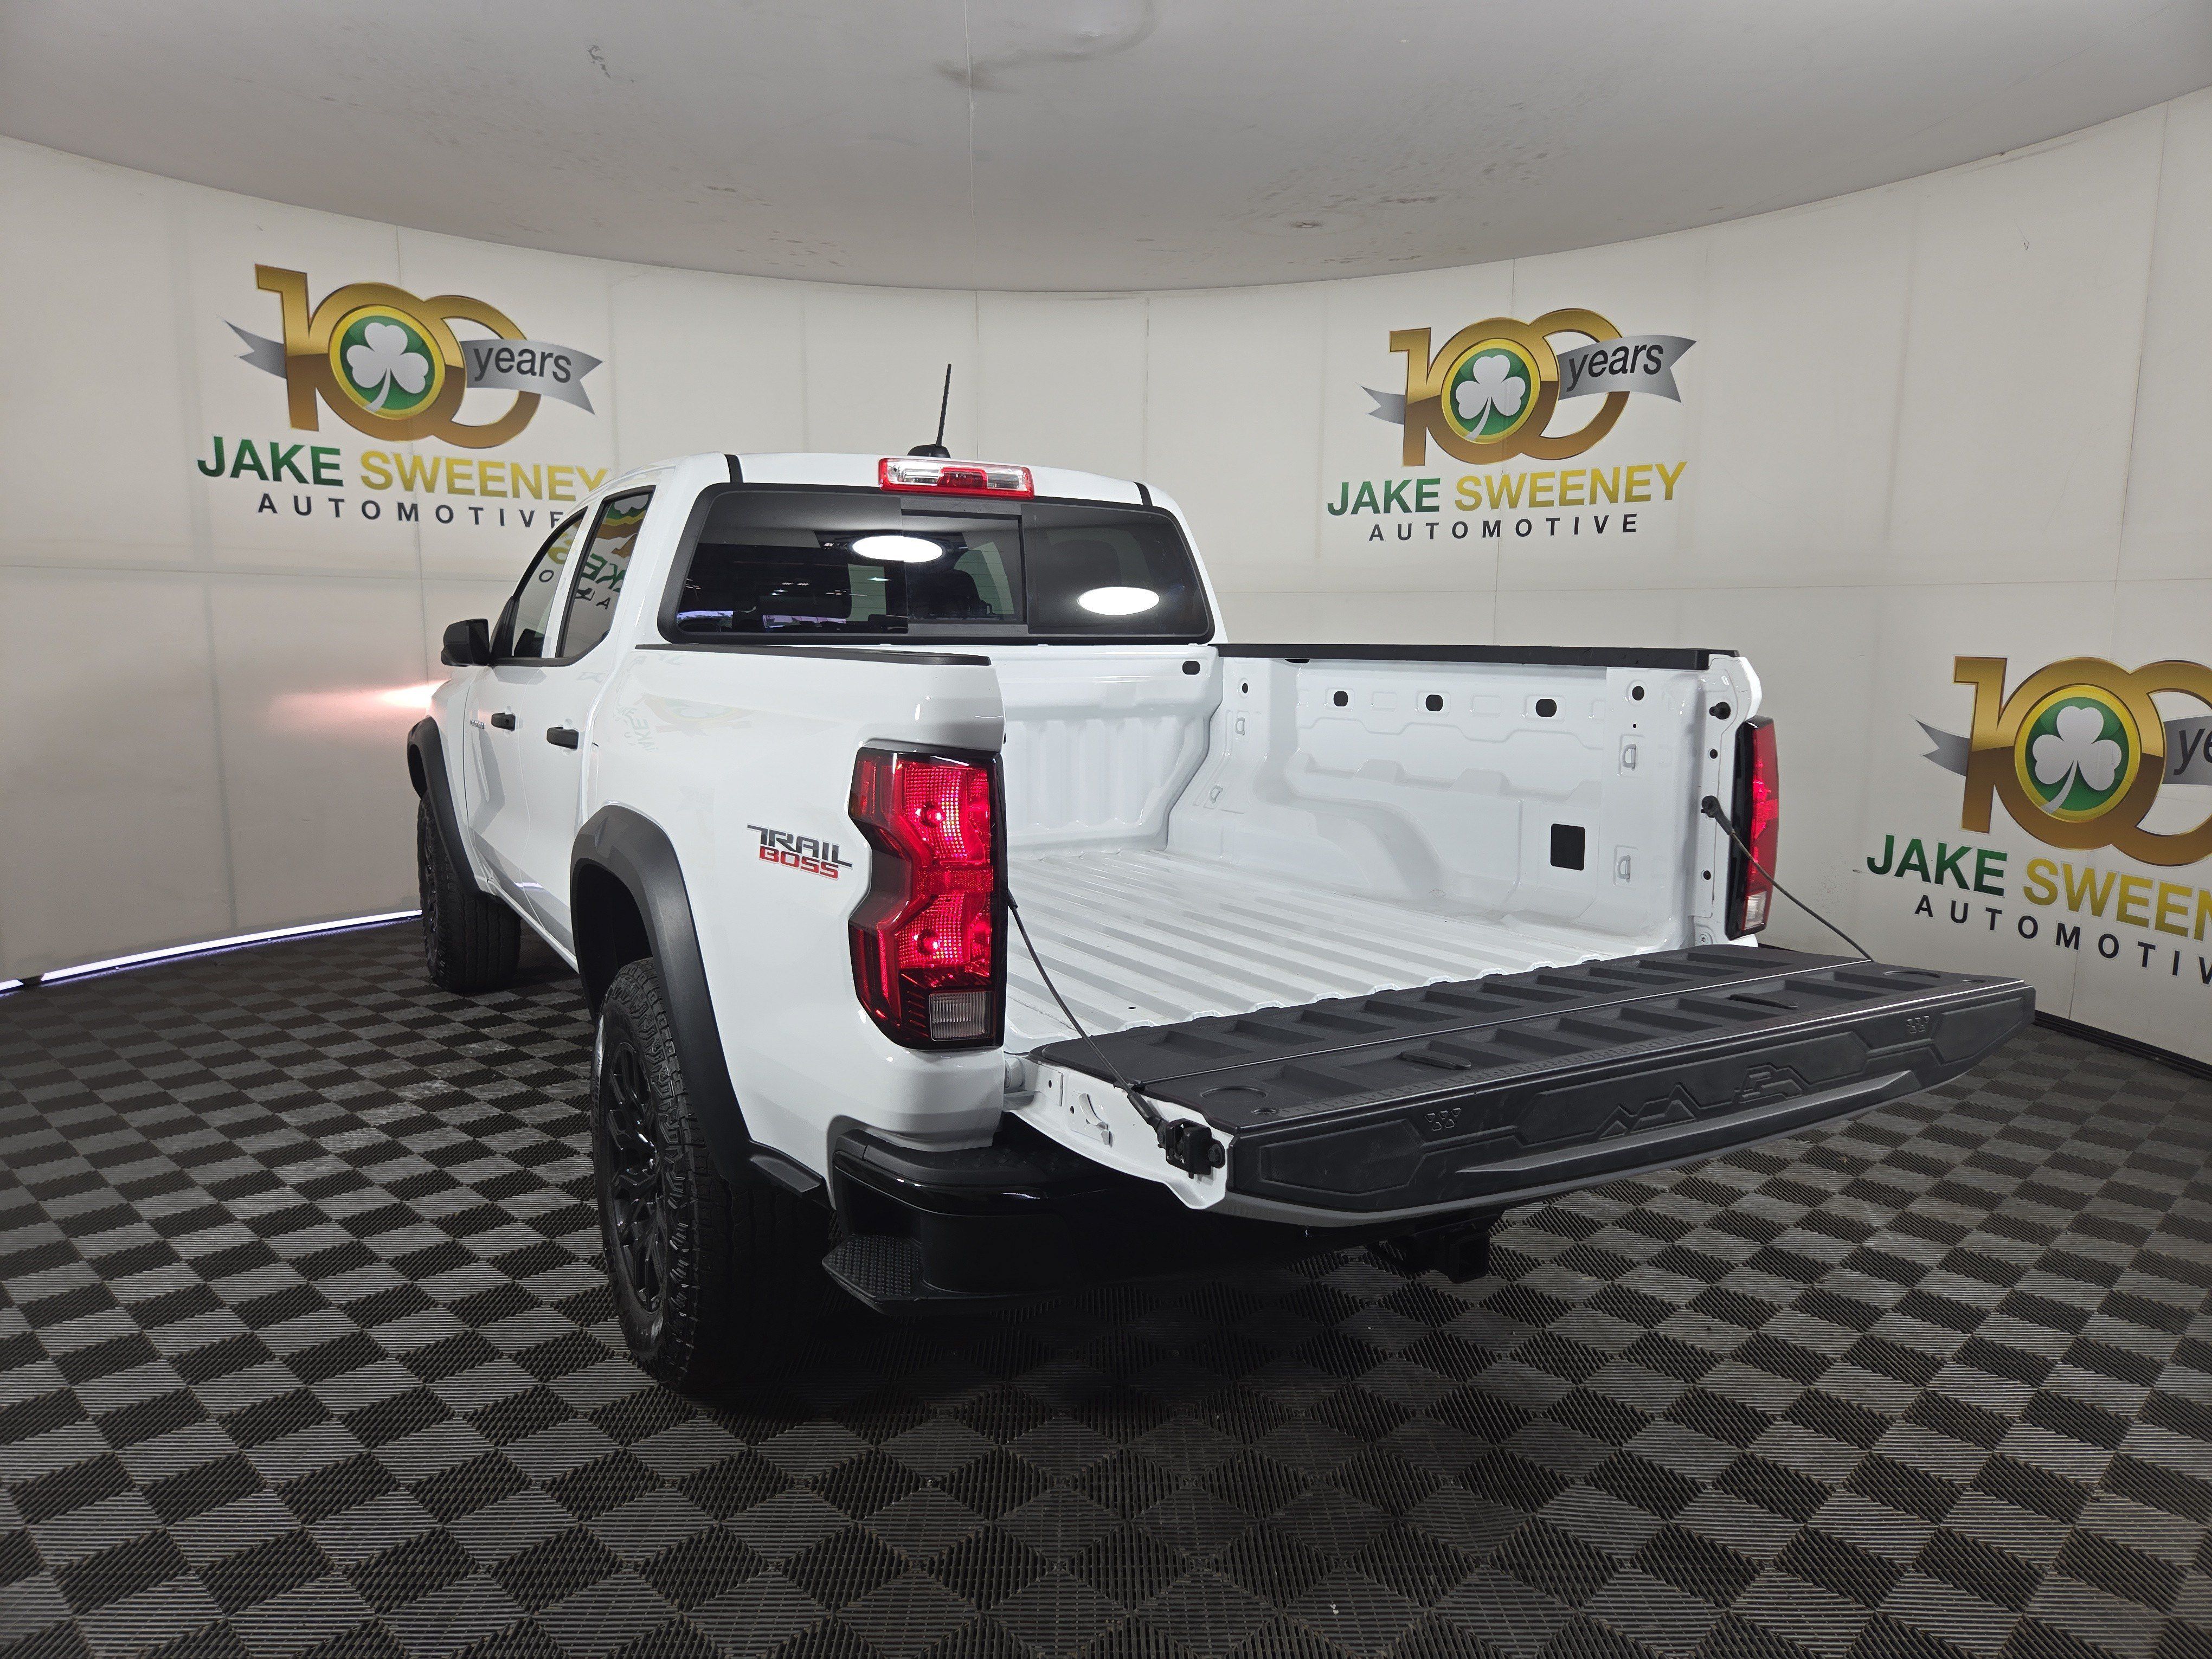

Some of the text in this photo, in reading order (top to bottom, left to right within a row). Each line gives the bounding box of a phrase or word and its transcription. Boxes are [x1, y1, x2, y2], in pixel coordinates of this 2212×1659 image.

[255, 263, 542, 449] 100
[473, 348, 571, 383] years
[1566, 342, 1663, 391] years
[1389, 308, 1631, 466] 100
[197, 436, 608, 501] JAKE SWEENEY
[1327, 461, 1687, 516] JAKE SWEENEY
[1369, 513, 1637, 541] AUTOMOTIVE
[1954, 657, 2212, 866] 100
[747, 824, 853, 870] TRAIL
[760, 845, 839, 880] BOSS
[1867, 834, 2008, 896] JAKE
